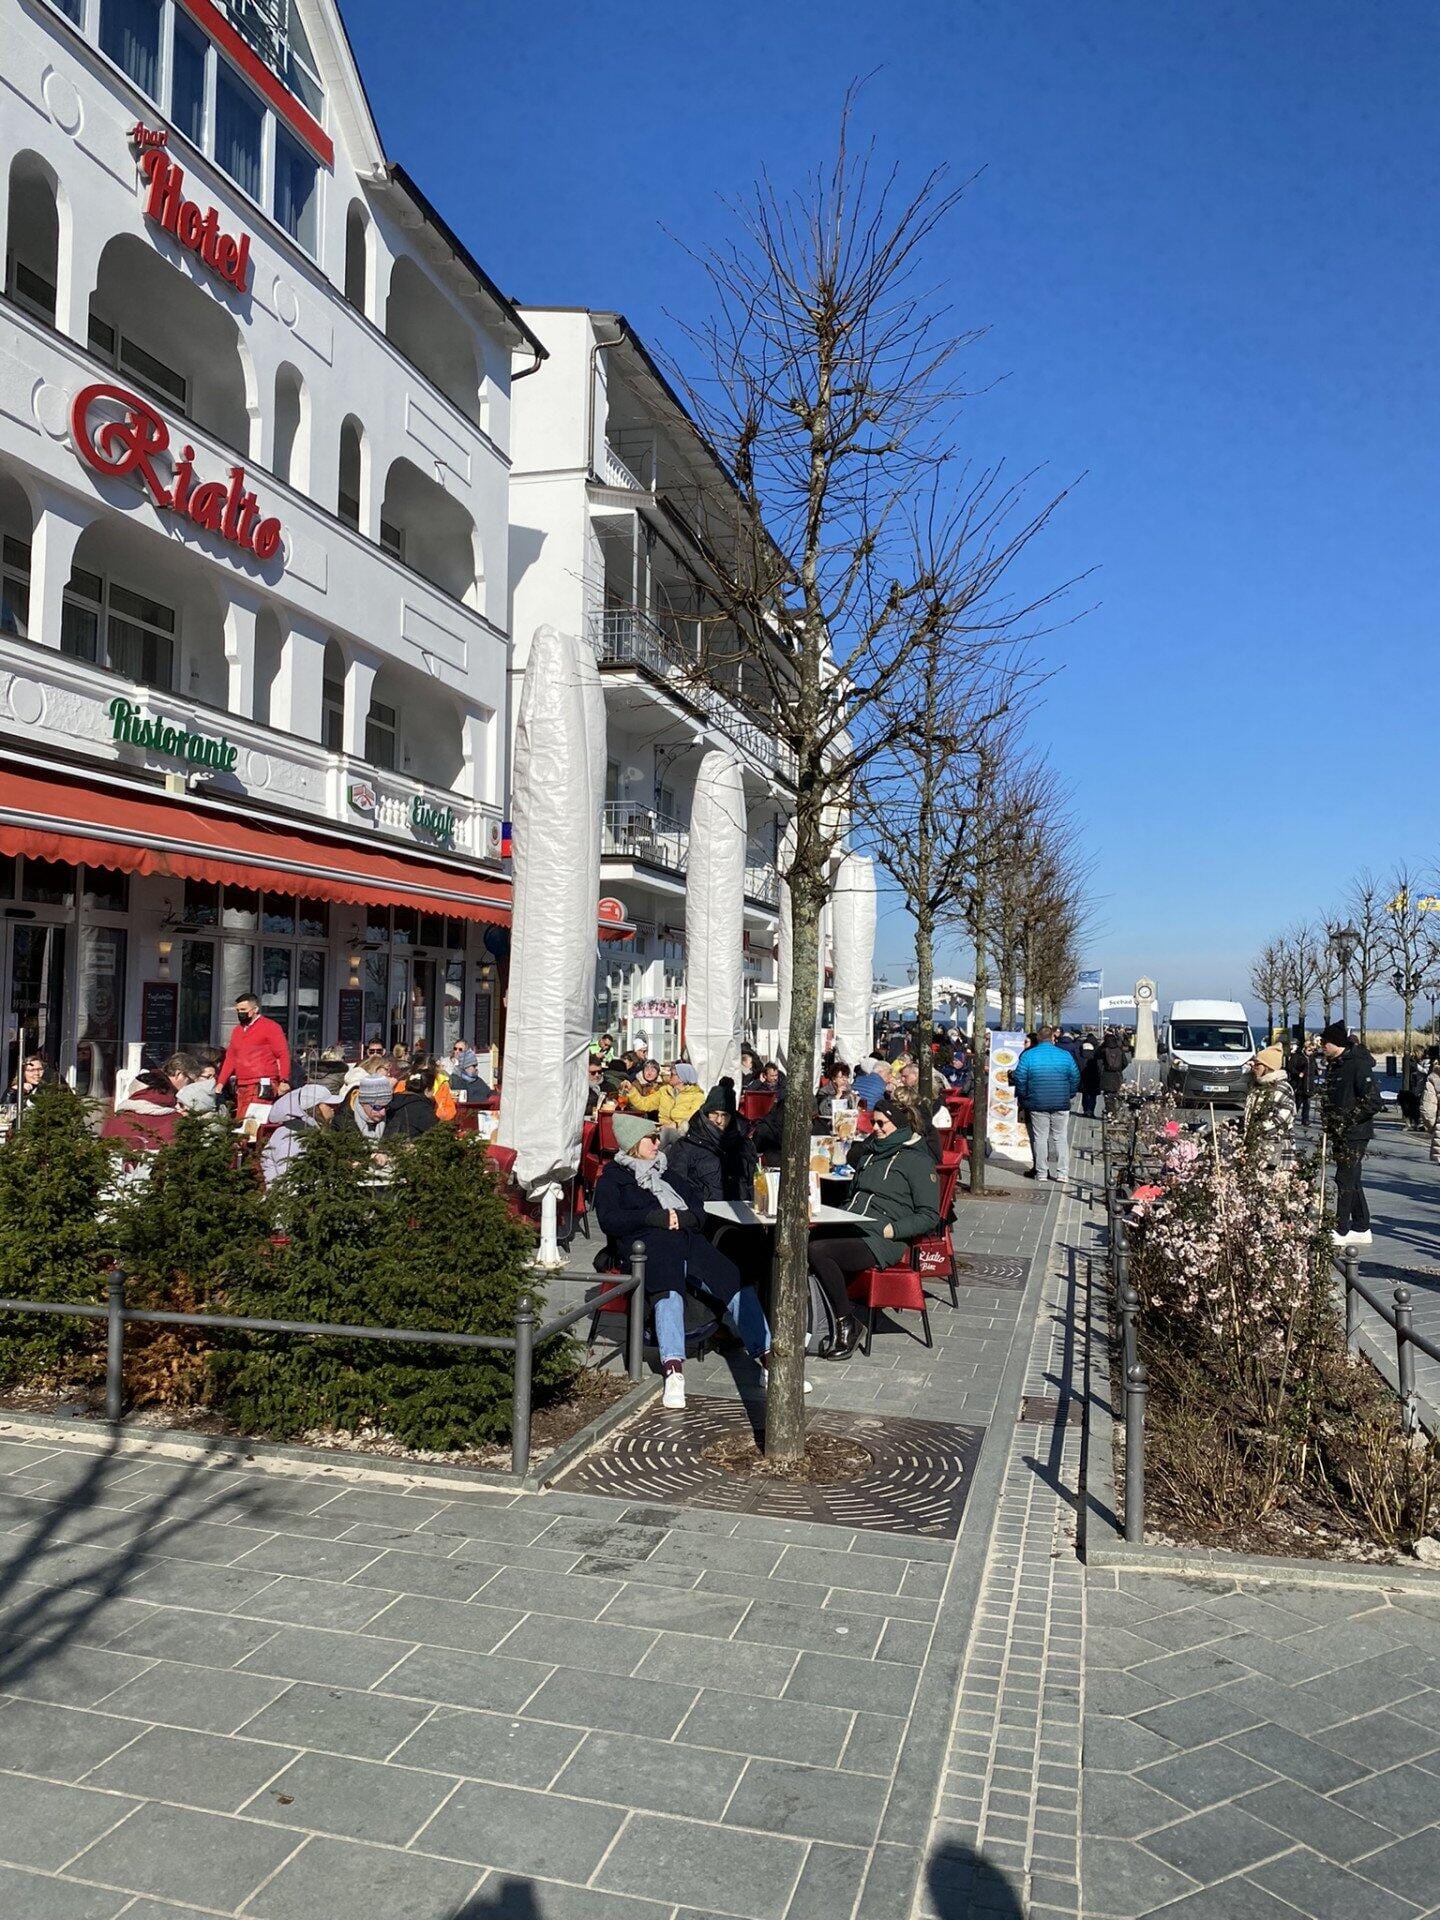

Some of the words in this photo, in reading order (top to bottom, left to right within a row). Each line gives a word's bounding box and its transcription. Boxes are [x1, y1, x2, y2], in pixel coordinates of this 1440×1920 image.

[130, 121, 169, 148] Apart
[139, 150, 251, 294] Hotel
[69, 383, 282, 560] Rialto
[108, 697, 238, 773] Ristorante
